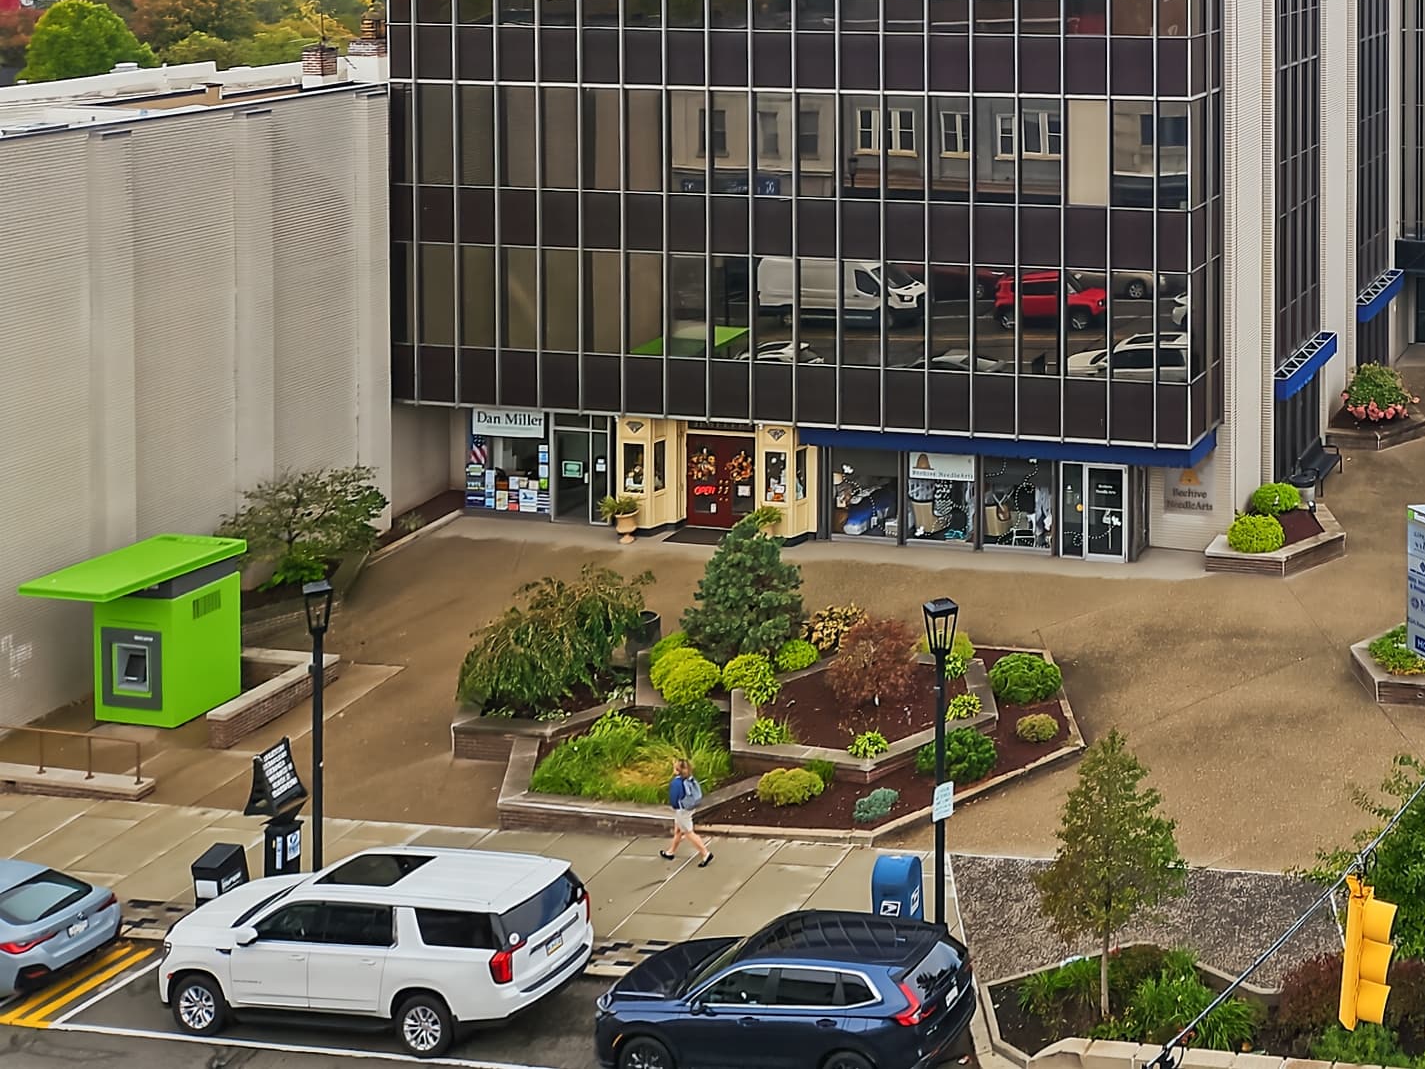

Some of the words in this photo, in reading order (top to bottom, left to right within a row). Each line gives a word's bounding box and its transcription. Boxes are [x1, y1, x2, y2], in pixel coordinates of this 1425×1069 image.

[477, 410, 501, 425] Dan
[505, 413, 543, 427] Miller
[694, 485, 716, 495] OPEN
[1172, 487, 1208, 499] Beehive
